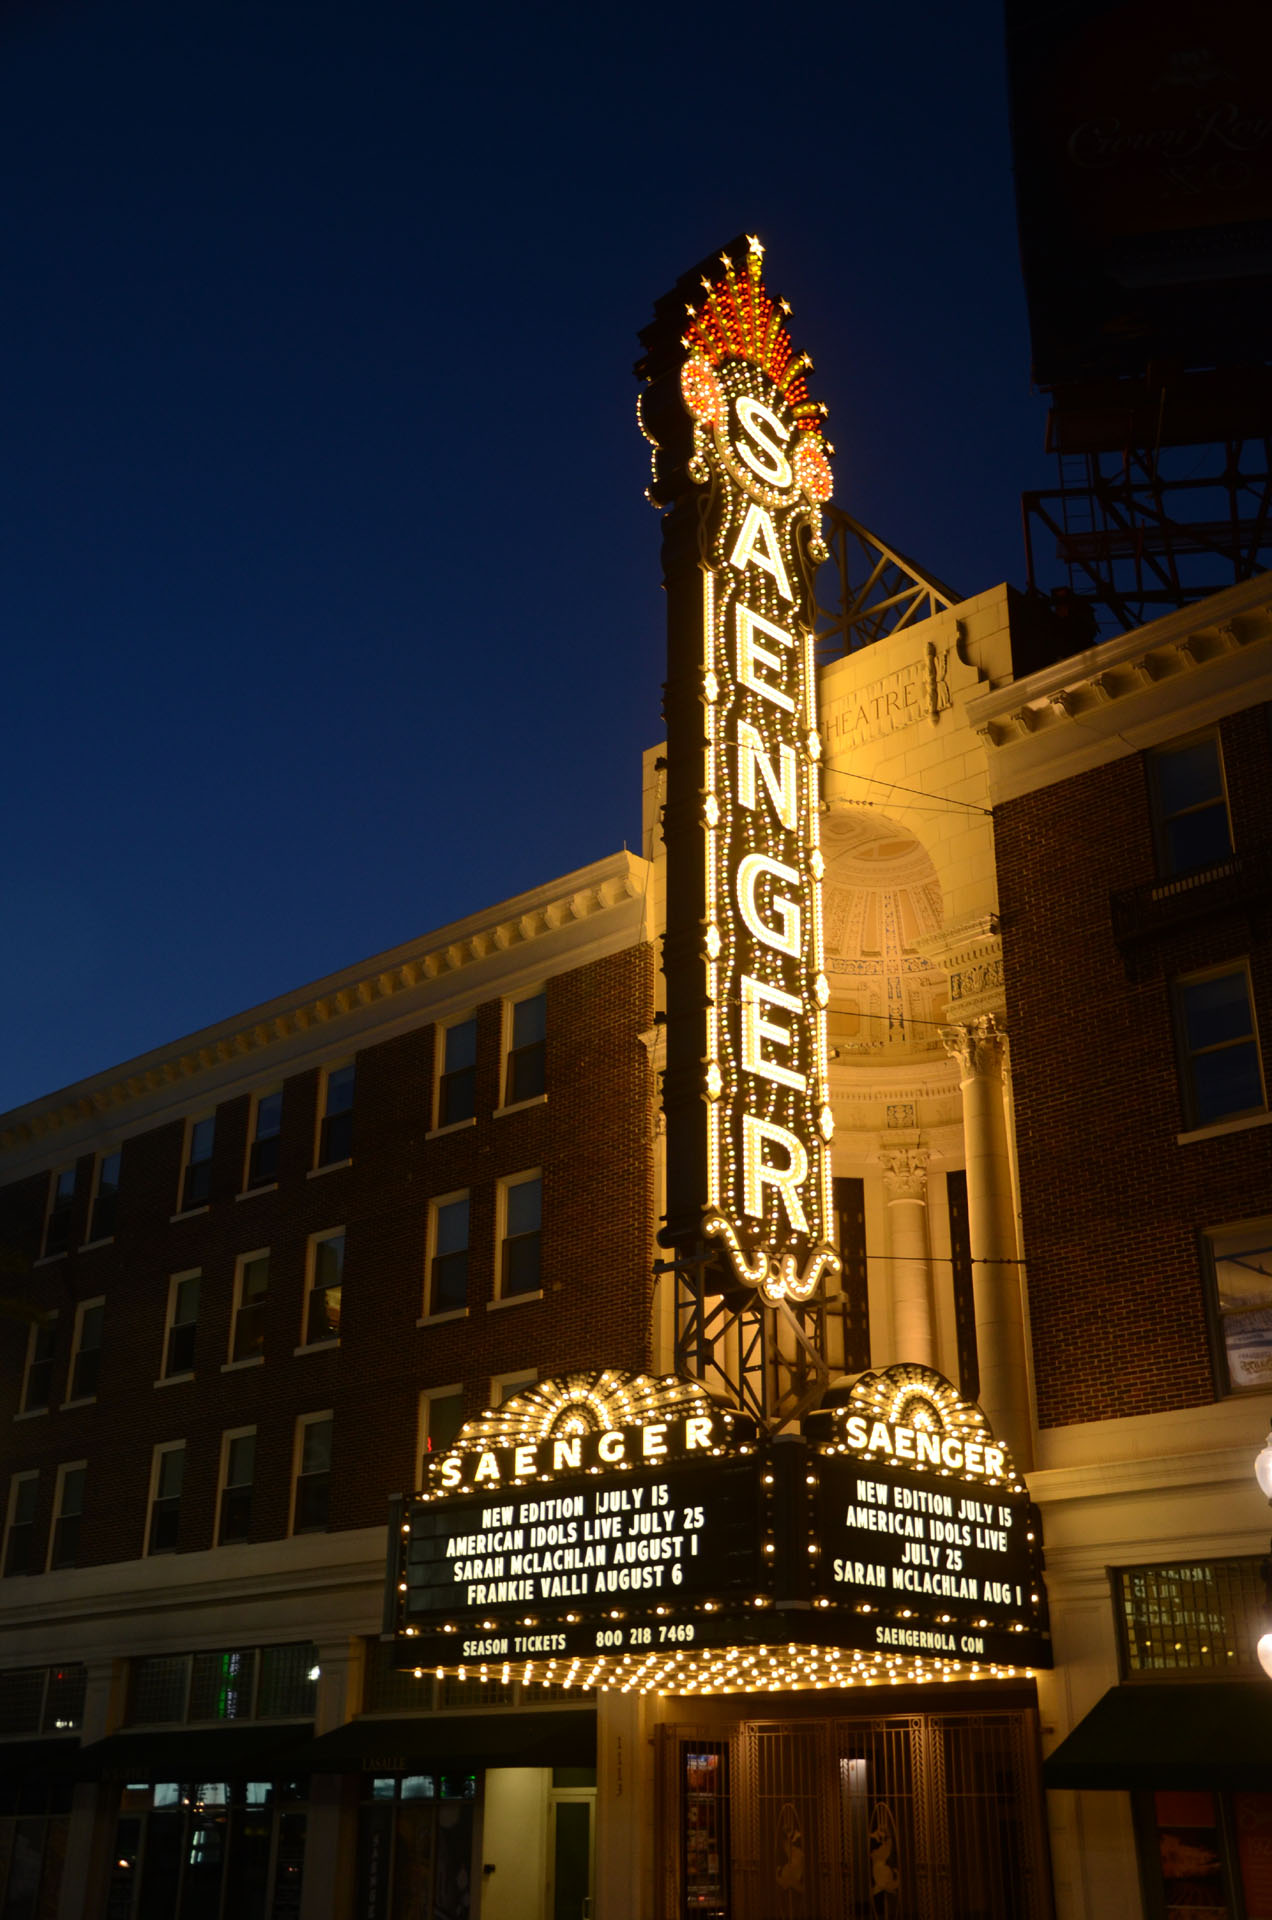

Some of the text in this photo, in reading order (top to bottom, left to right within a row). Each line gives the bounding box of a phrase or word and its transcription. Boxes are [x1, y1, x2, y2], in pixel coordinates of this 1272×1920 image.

[820, 682, 918, 742] HEATRE
[728, 394, 812, 1235] SAENGER
[441, 1417, 713, 1486] SAENGER
[846, 1416, 1004, 1477] SAENGER
[482, 1485, 668, 1528] NEW EDITION JULY 15
[857, 1480, 1012, 1527] NEW EDITION JULY 15
[446, 1507, 704, 1557] AMERICAN IDOLS LIVE JULY 25
[846, 1505, 1007, 1552] AMERICAN IDOLS LIVE
[454, 1535, 698, 1581] SARAH MCLACHLAN AUGUST 1
[902, 1542, 962, 1571] JULY 25
[467, 1564, 682, 1605] FRANKIE VALLI AUGUST 6
[833, 1560, 885, 1587] SARAH
[892, 1568, 978, 1600] MCLACHLAN
[984, 1581, 1012, 1603] AUG
[463, 1625, 694, 1656] SEASON TICKETS 800 218 7469
[876, 1626, 984, 1654] SAENGERNOLA COM
